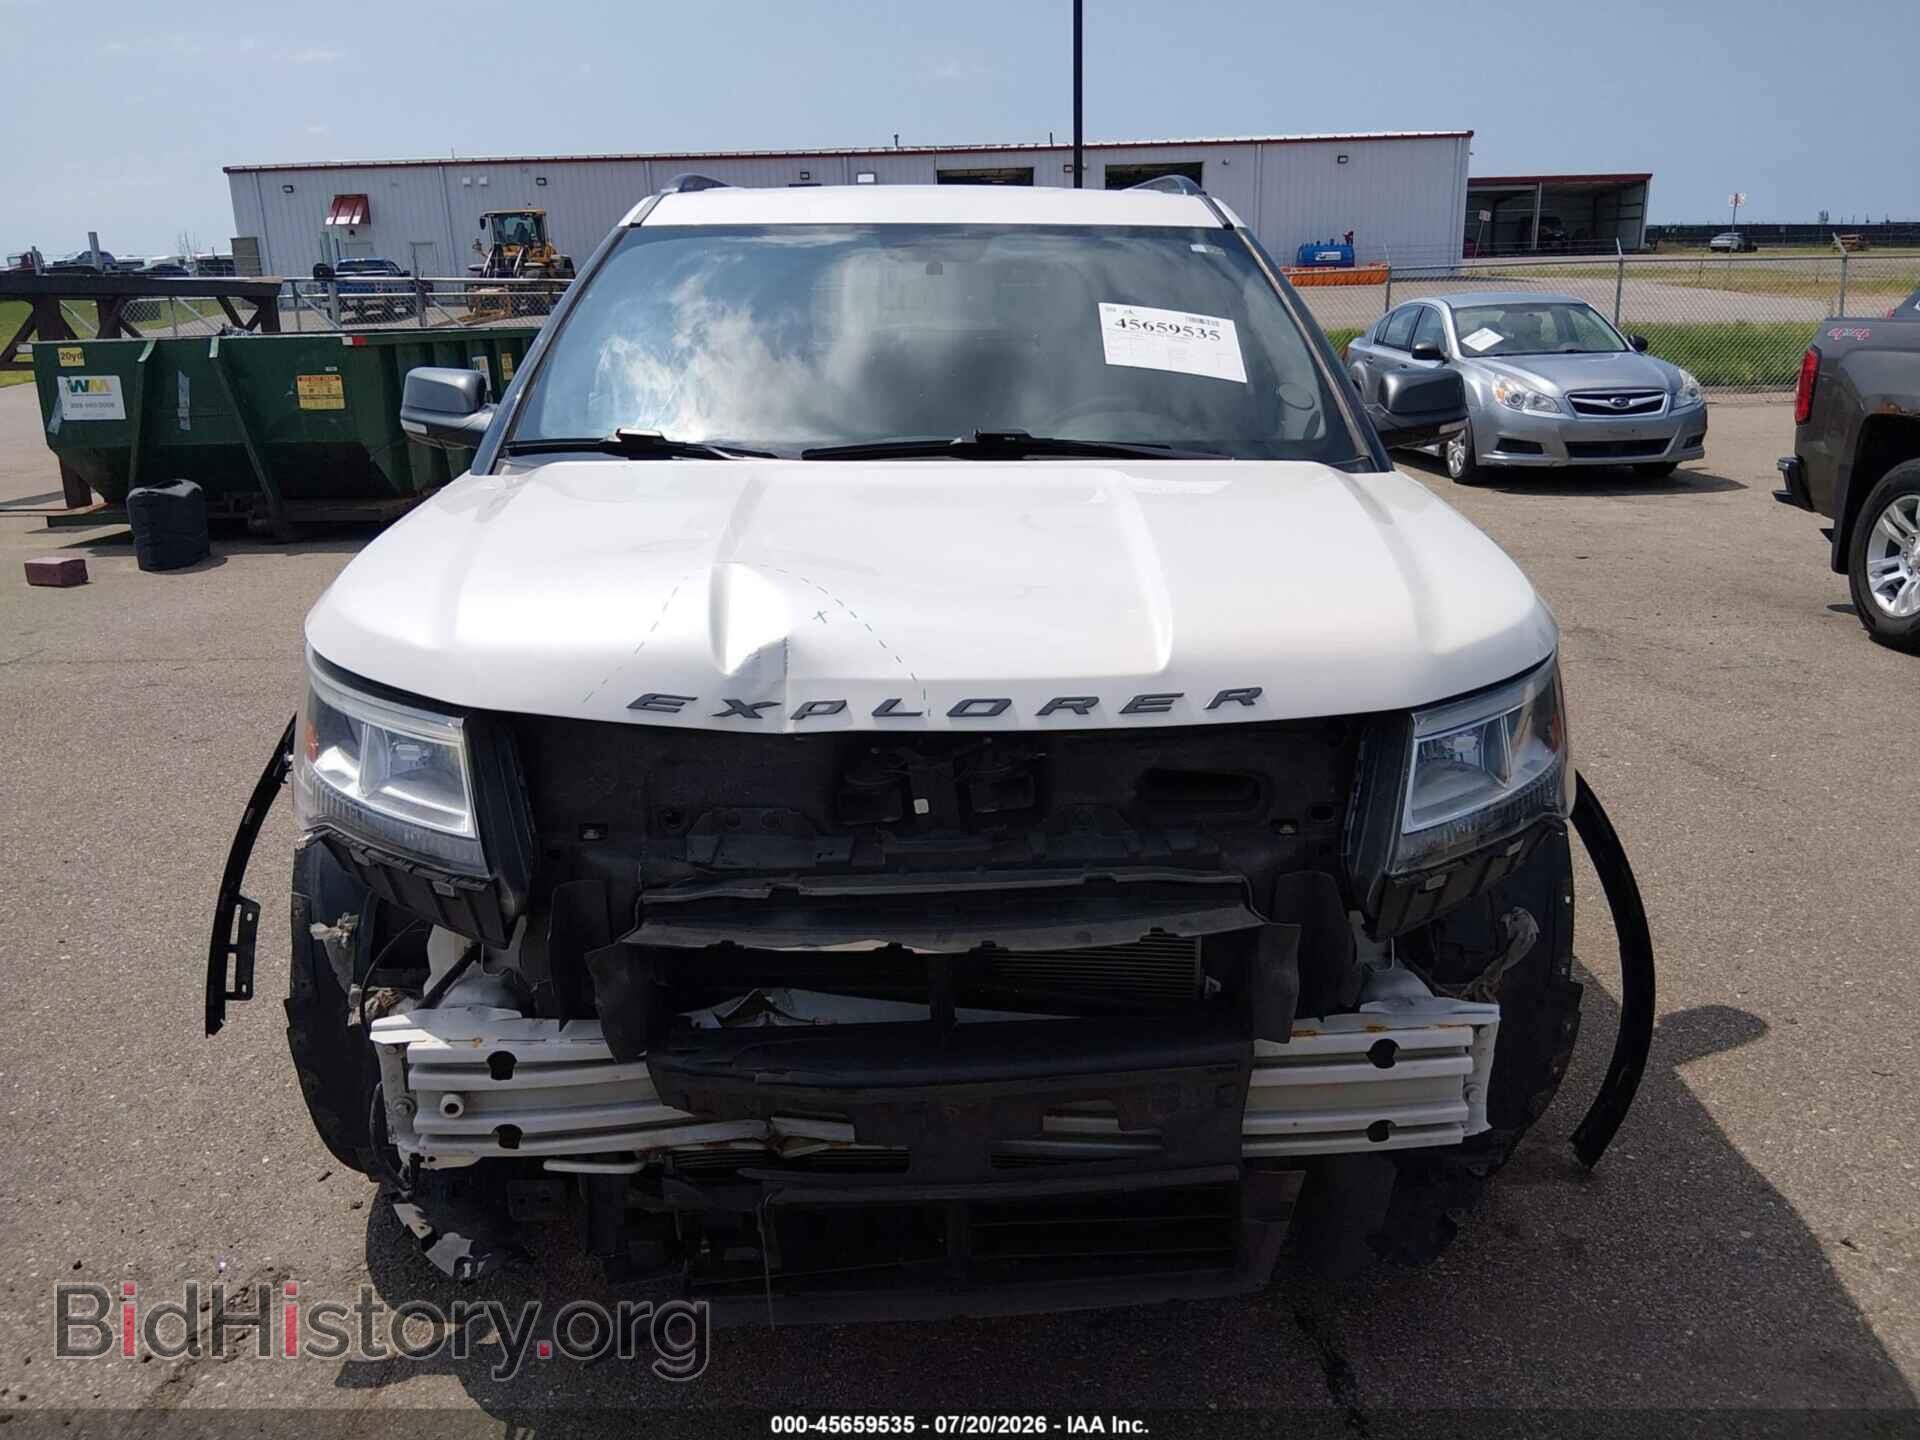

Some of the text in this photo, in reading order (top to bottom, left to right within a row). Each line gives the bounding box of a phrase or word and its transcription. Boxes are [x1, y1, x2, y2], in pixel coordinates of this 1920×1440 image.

[1114, 317, 1222, 342] 45659535
[61, 351, 83, 362] 20yd
[68, 379, 113, 393] WM
[626, 687, 1264, 721] EXPLORER
